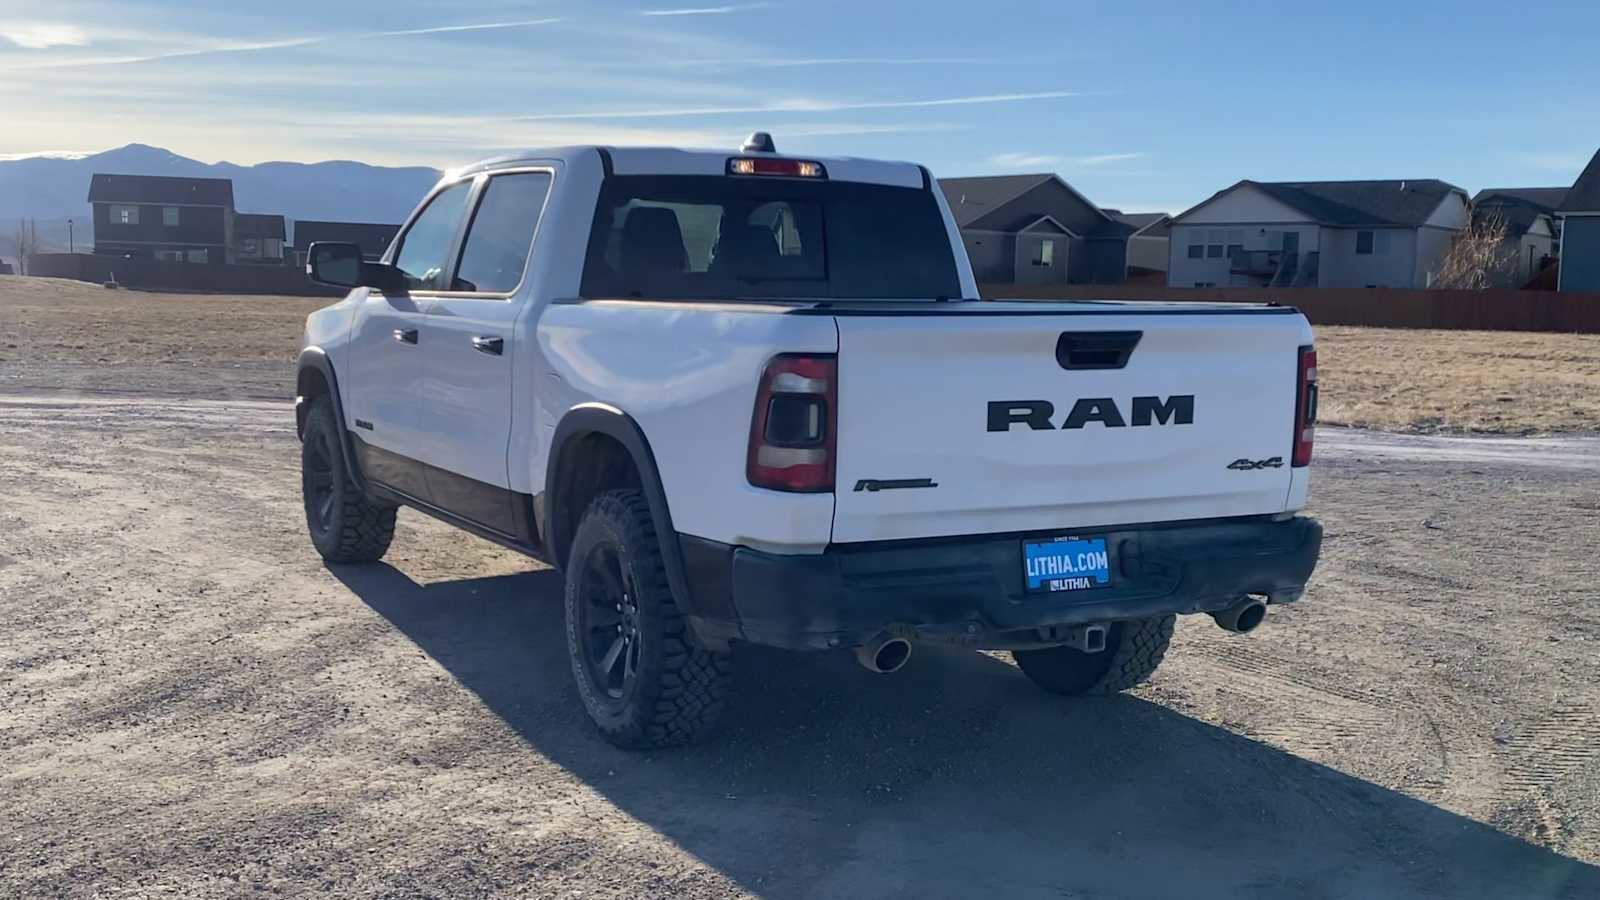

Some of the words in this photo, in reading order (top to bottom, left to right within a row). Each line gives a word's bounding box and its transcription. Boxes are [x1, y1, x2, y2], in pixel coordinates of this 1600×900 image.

[987, 395, 1195, 431] RAM
[1026, 551, 1108, 576] LITHIA.COM
[1060, 578, 1091, 590] LITHIA
